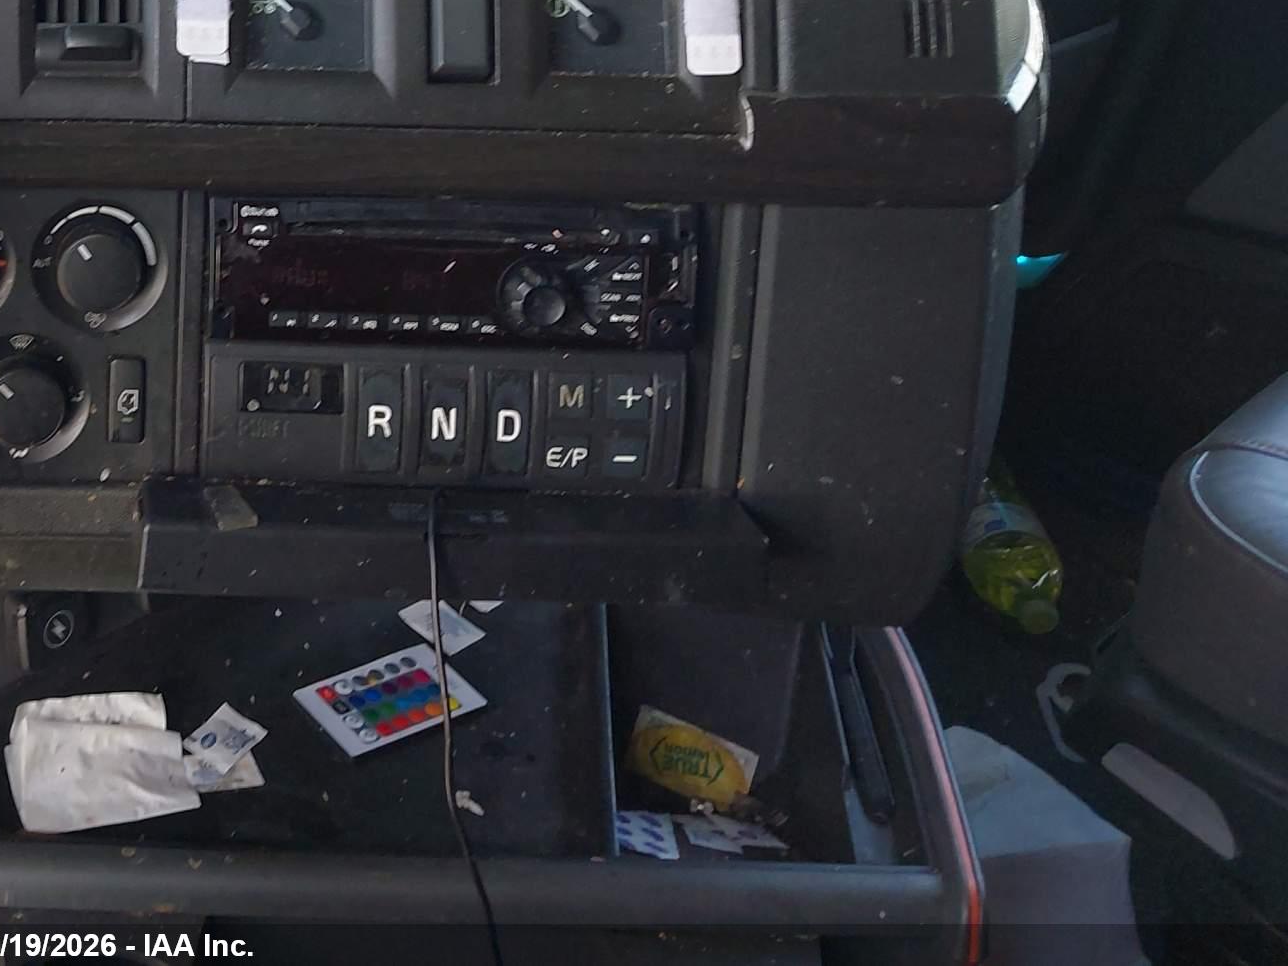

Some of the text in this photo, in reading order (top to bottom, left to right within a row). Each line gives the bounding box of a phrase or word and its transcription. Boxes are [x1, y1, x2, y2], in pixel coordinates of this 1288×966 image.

[559, 385, 584, 407] M
[367, 404, 522, 442] R N D
[546, 446, 588, 469] E/P
[662, 753, 712, 779] TRUE
